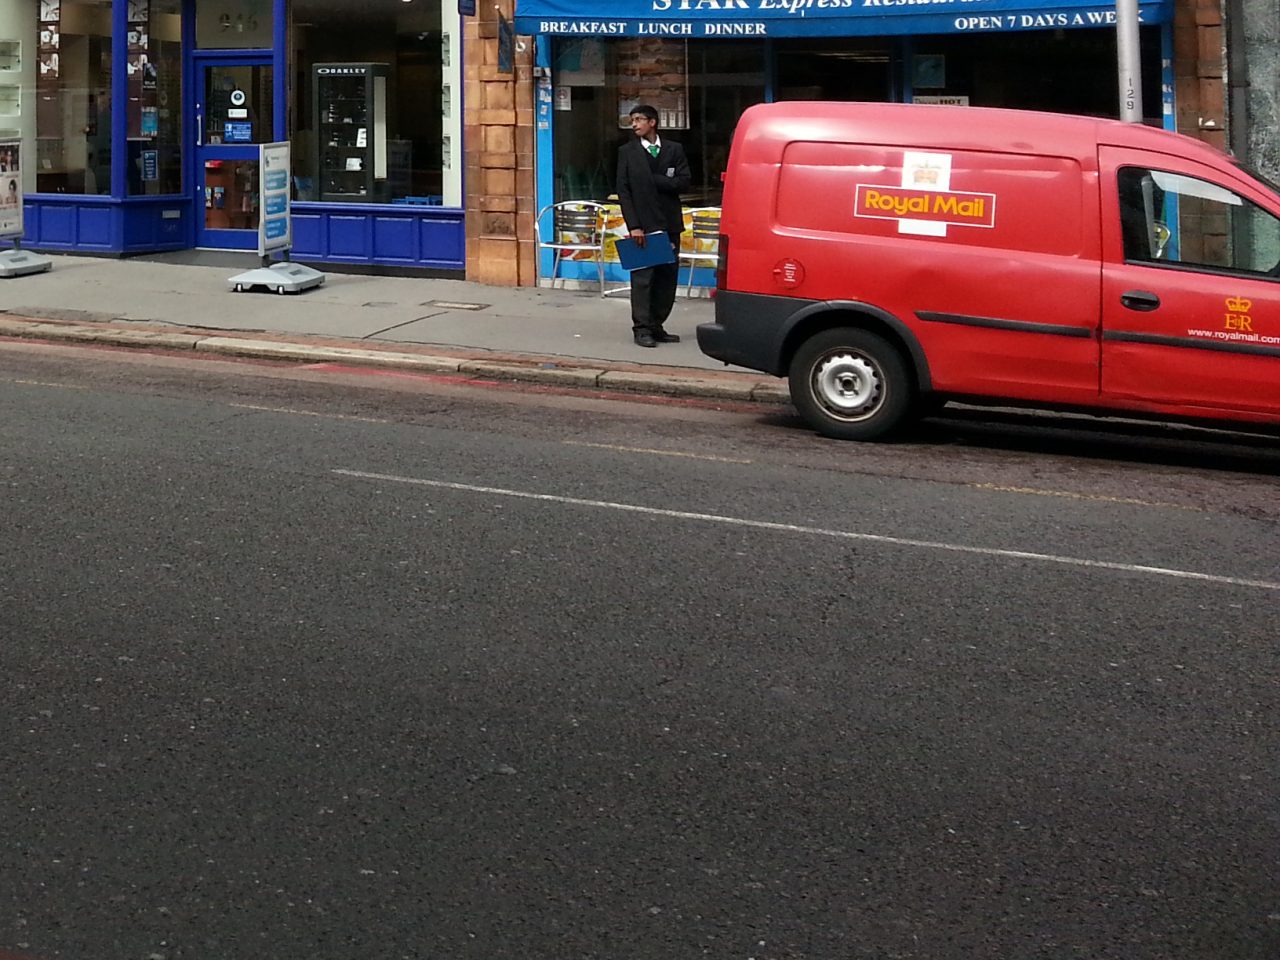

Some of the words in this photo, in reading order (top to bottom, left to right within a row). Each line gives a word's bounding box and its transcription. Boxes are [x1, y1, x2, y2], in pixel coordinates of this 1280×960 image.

[539, 21, 628, 34] BREAKFAST
[638, 22, 693, 35] LUNCH
[704, 22, 767, 35] DINNER
[954, 15, 1003, 30] OPEN
[1007, 15, 1017, 28] 7
[1021, 13, 1068, 27] DAYS
[1071, 13, 1085, 25] A
[1126, 77, 1135, 110] 129
[864, 189, 929, 216] Royal
[932, 194, 985, 218] Mail
